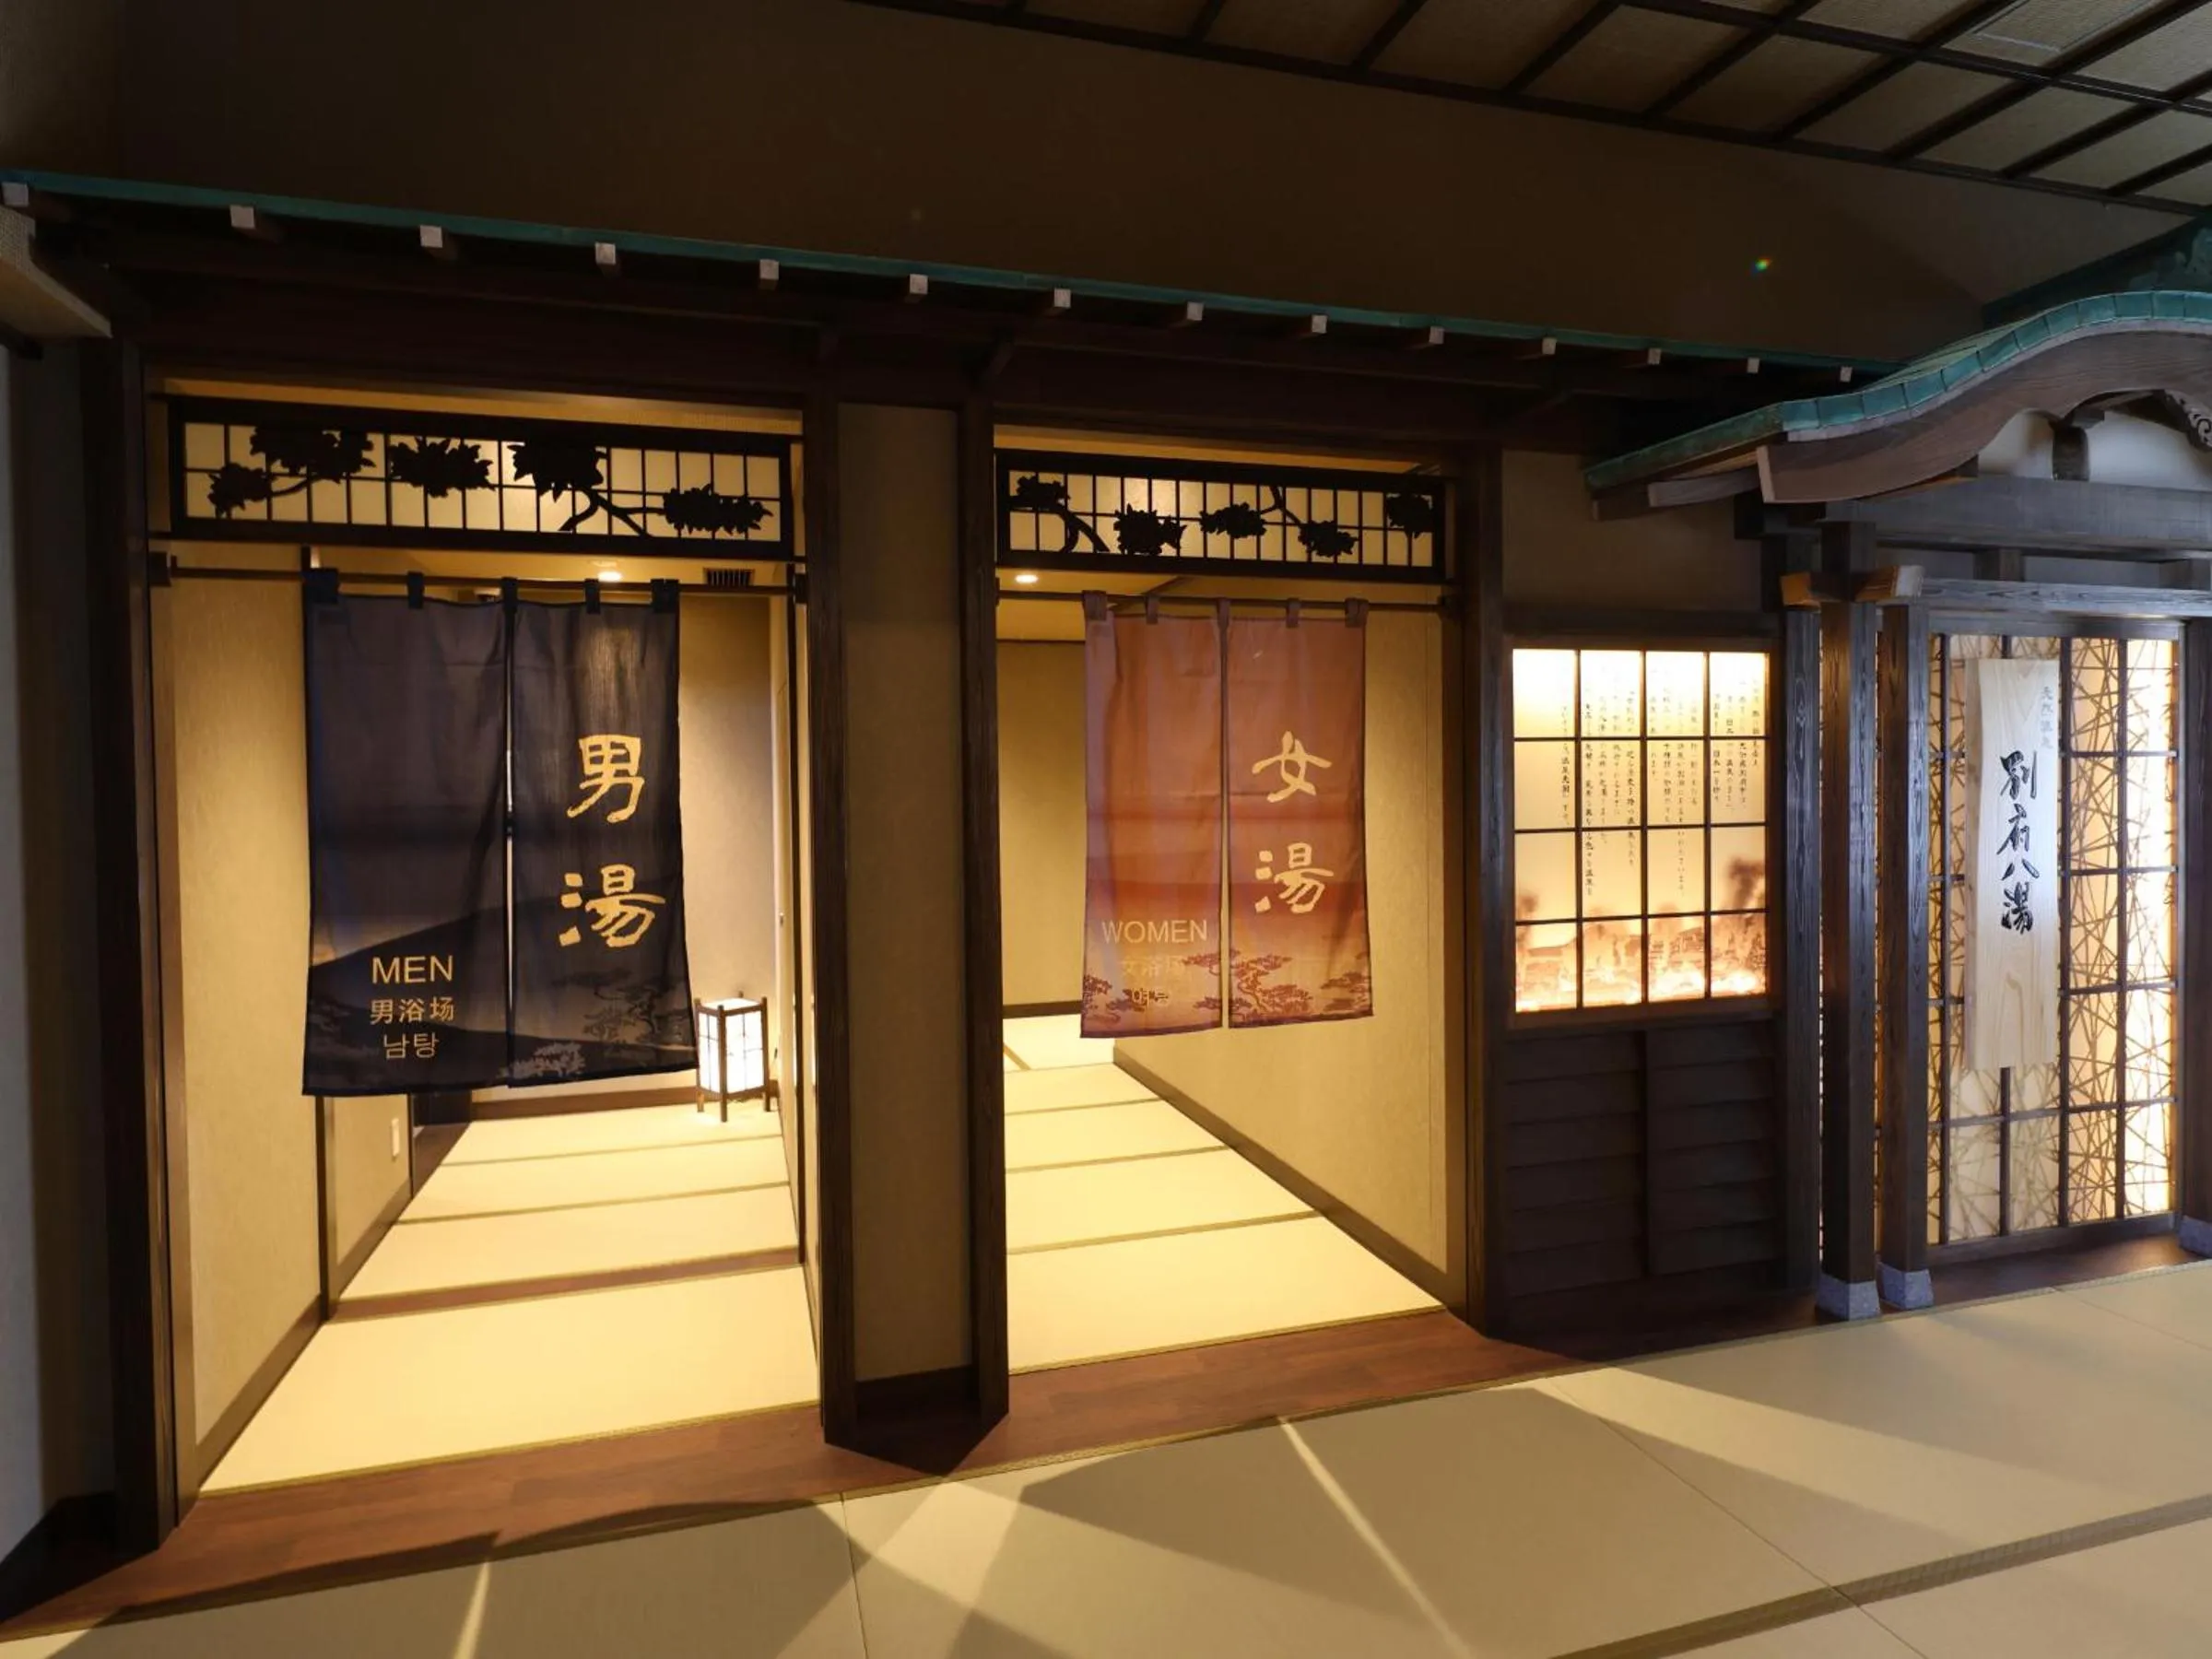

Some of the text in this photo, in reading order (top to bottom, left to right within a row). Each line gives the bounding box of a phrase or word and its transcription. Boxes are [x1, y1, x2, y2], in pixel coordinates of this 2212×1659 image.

[1252, 730, 1335, 914] 女湯
[559, 734, 665, 948] 男湯
[1996, 750, 2040, 935] 別府八湯
[1101, 918, 1208, 945] WOMEN
[372, 955, 453, 984] MEN
[371, 996, 454, 1026] 男浴场
[383, 1031, 440, 1060] 남탕
